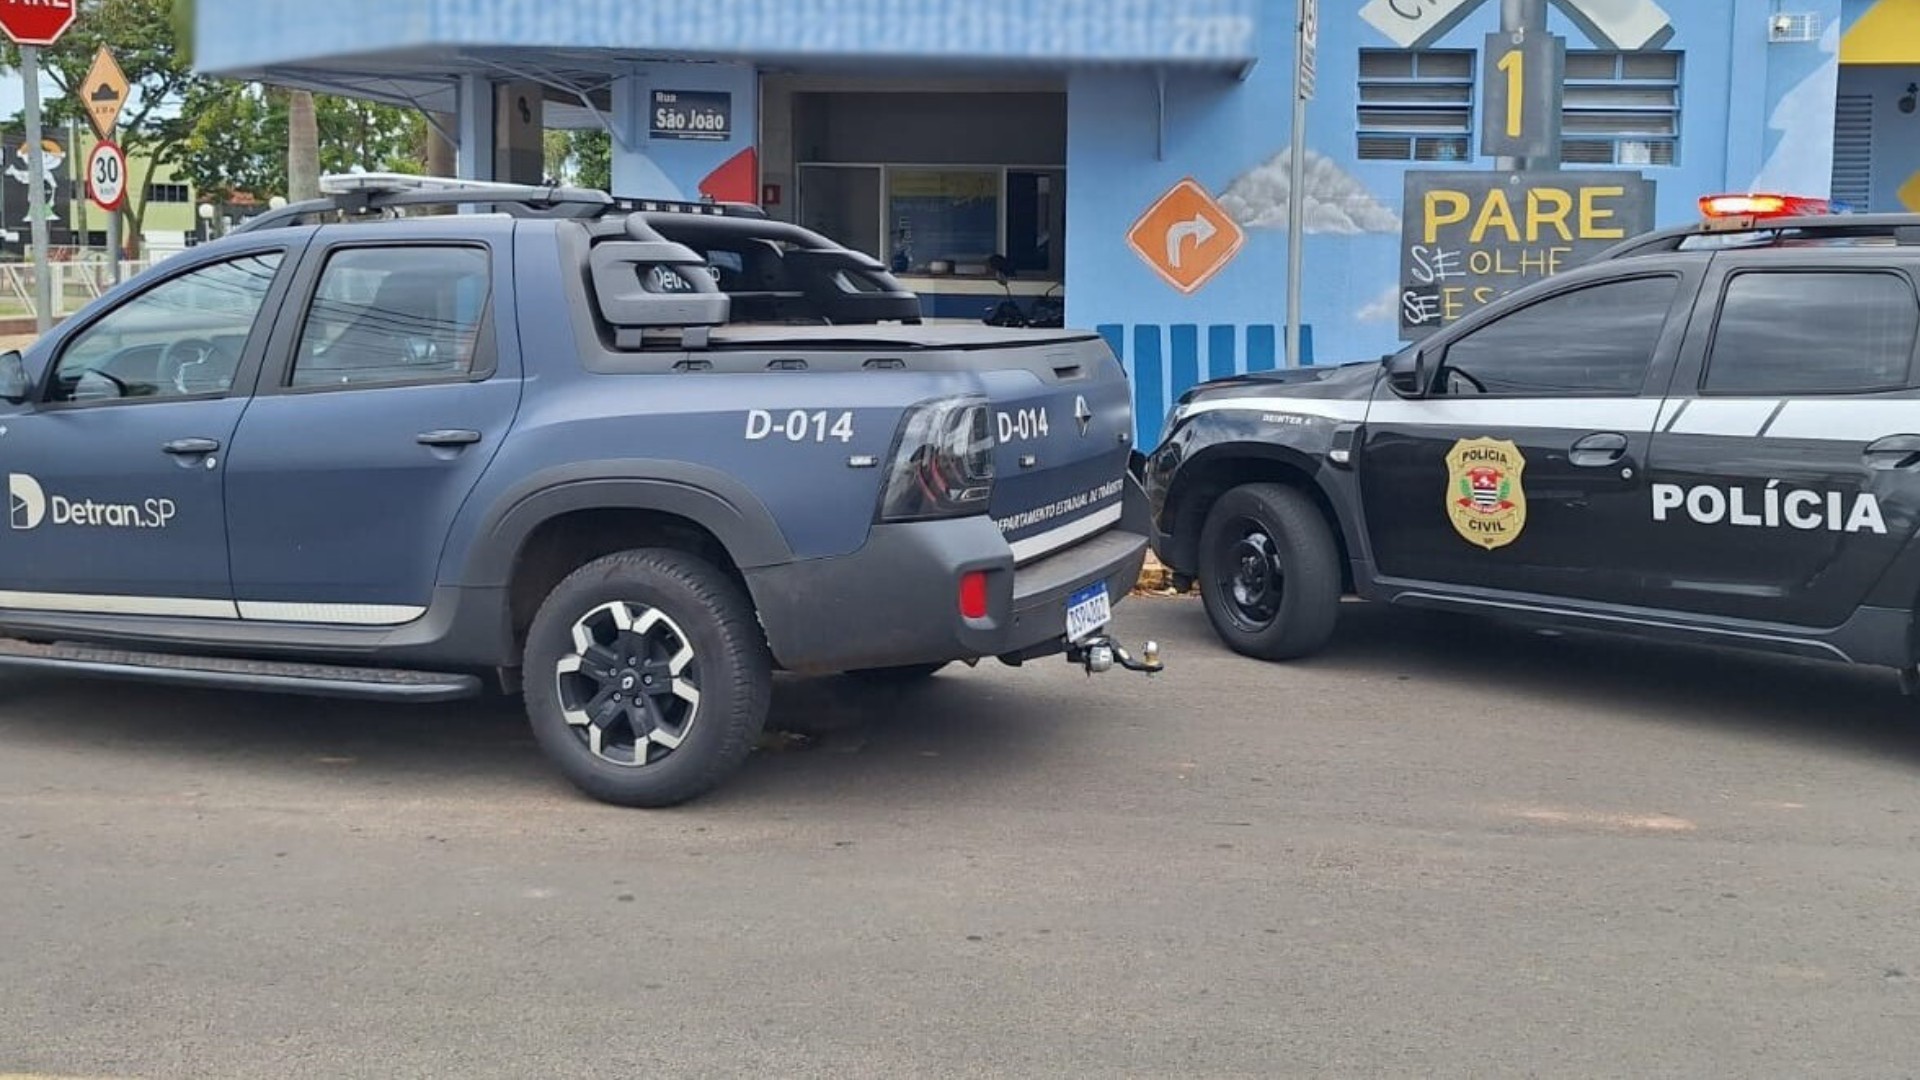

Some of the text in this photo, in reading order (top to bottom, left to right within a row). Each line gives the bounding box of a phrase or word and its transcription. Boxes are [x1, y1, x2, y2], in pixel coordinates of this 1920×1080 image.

[656, 91, 677, 103] Rua
[1497, 50, 1525, 138] 1
[656, 107, 724, 130] São João
[96, 156, 118, 184] 30
[1423, 186, 1625, 243] PARE
[1411, 245, 1467, 282] SE
[1403, 291, 1442, 324] SE
[744, 409, 854, 442] D-014
[997, 407, 1049, 443] D-014
[1462, 448, 1508, 464] POLÍCIA
[52, 496, 176, 527] Detran.SP
[1652, 479, 1888, 534] POLÍCIA
[1468, 519, 1506, 533] CIVIL
